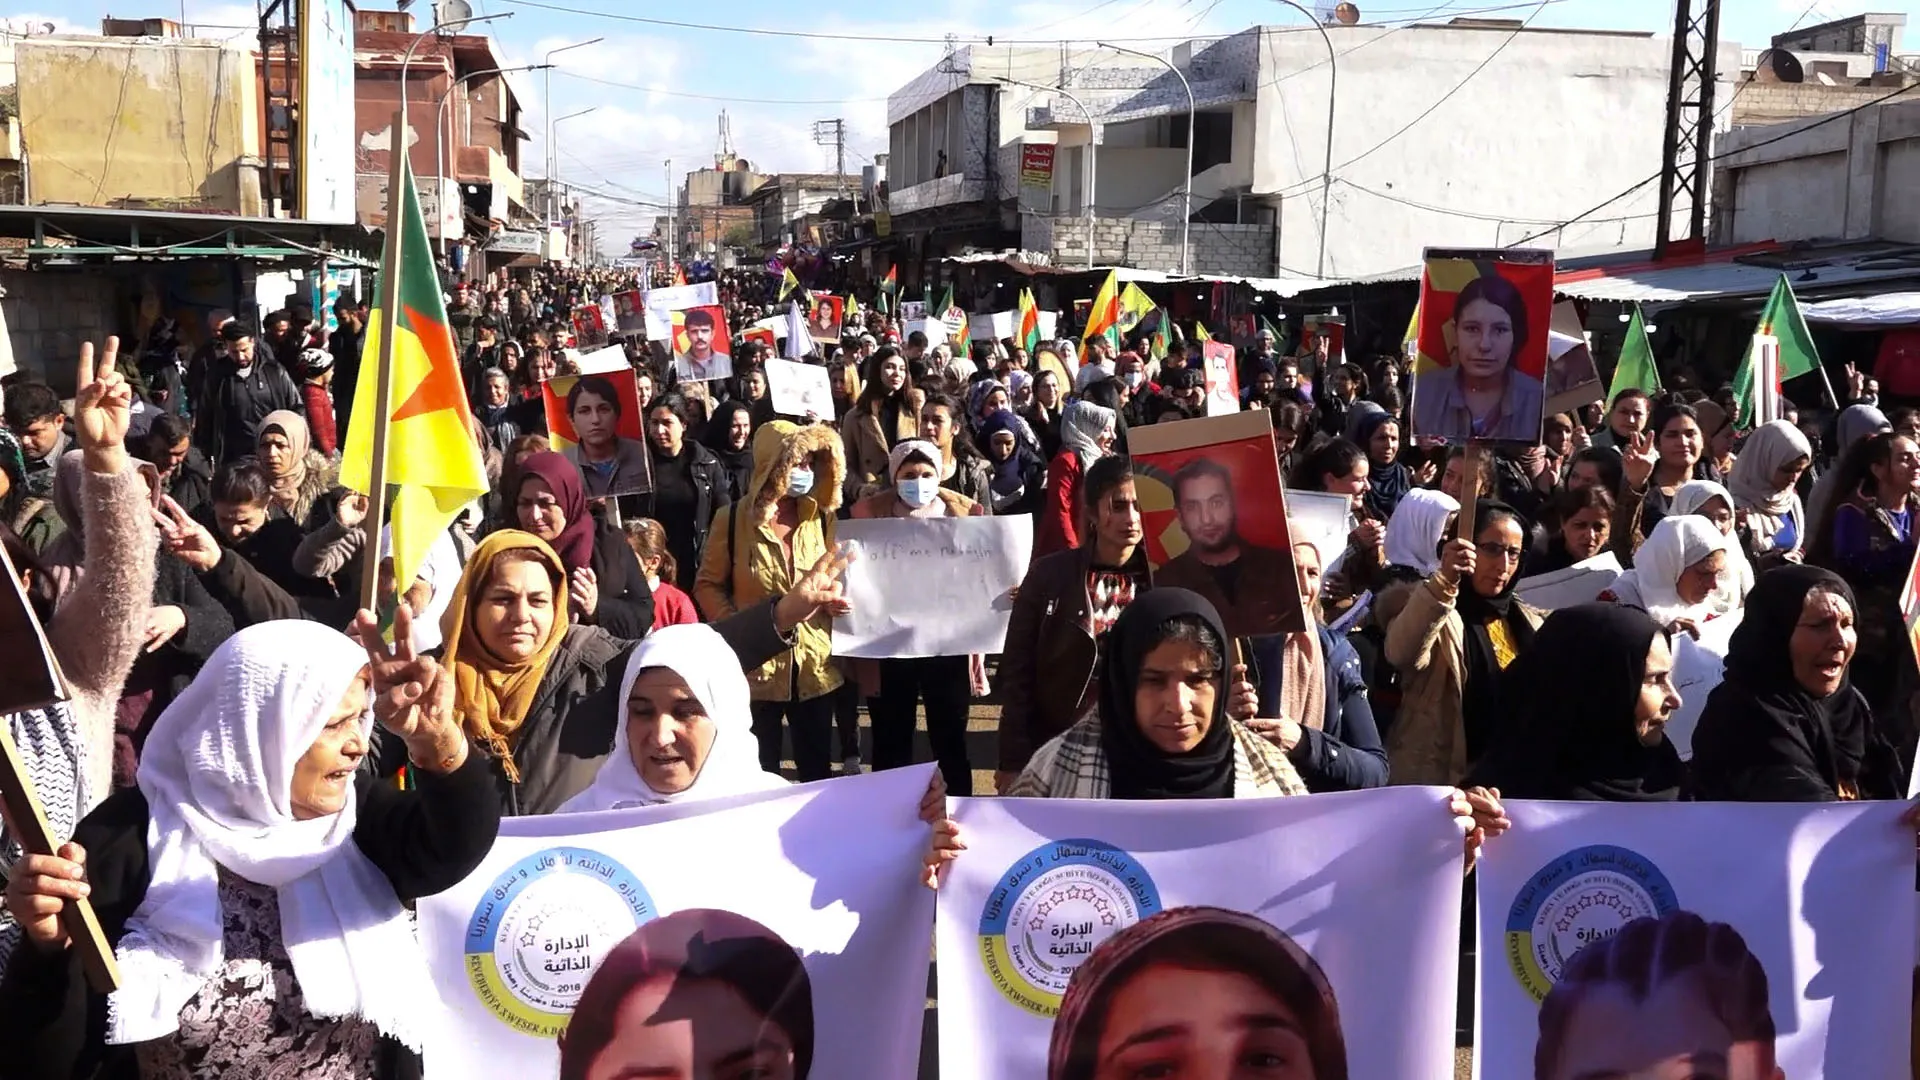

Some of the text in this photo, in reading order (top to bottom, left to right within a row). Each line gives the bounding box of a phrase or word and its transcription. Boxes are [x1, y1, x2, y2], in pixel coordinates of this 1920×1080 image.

[948, 309, 963, 318] NA
[545, 934, 590, 955] الإدارة
[1049, 941, 1093, 958] الذاتية
[545, 955, 591, 976] الذاتية
